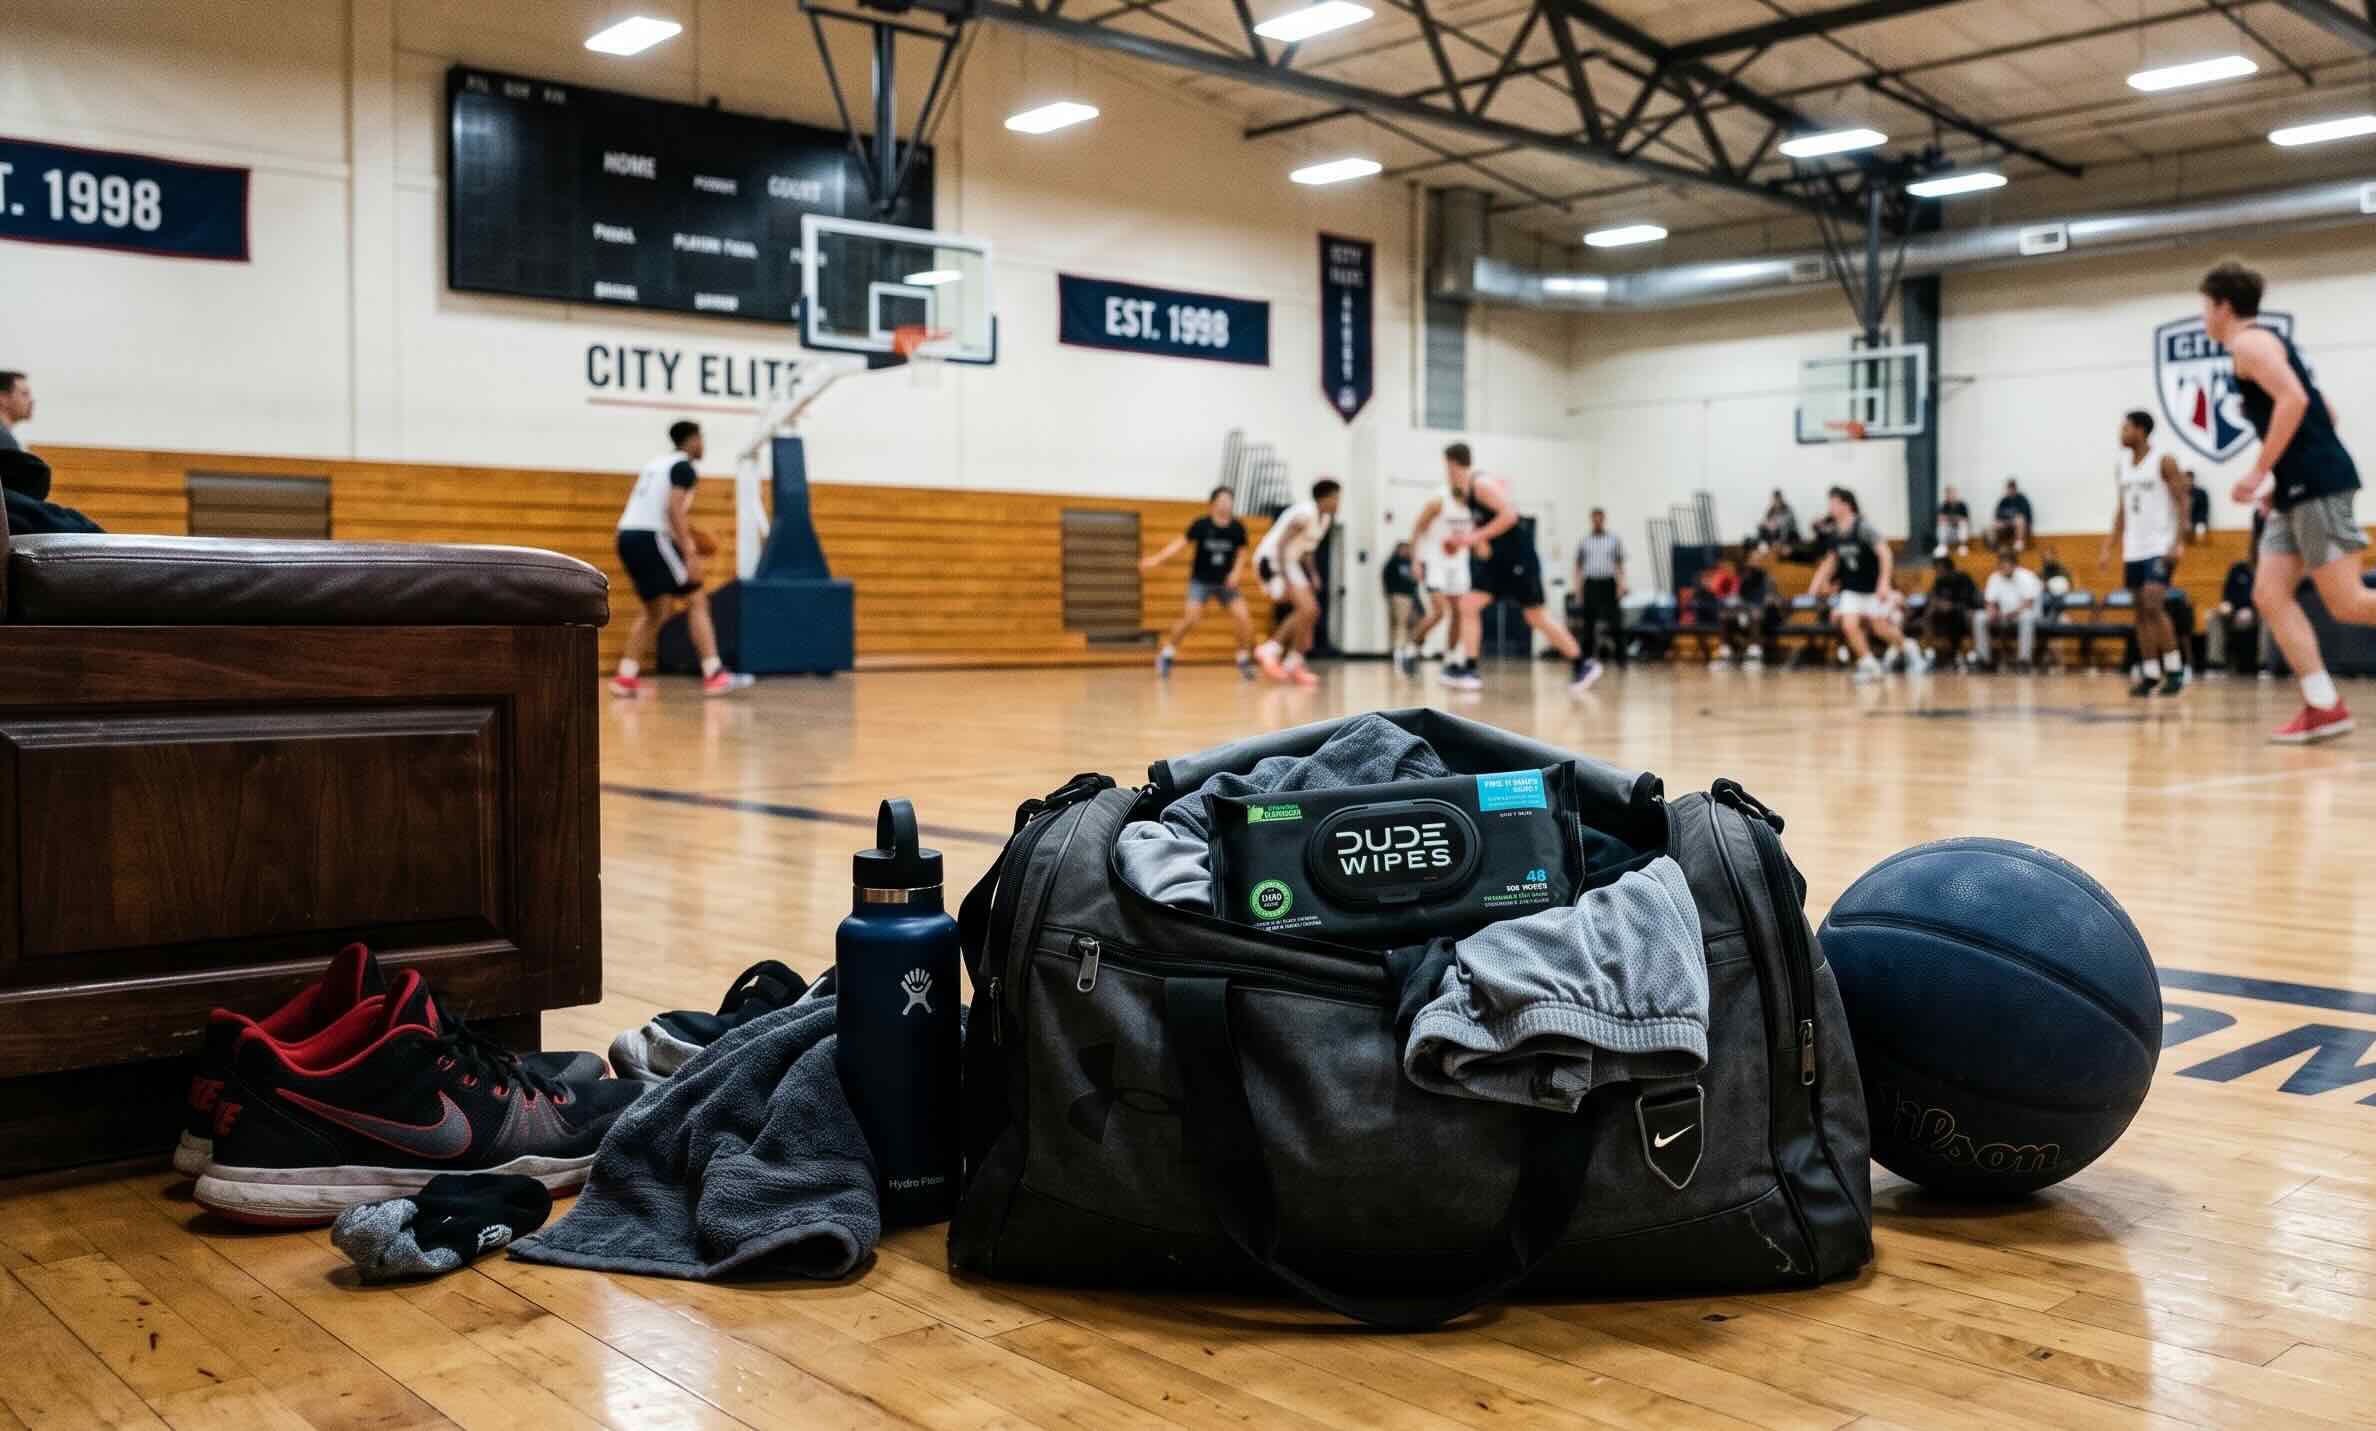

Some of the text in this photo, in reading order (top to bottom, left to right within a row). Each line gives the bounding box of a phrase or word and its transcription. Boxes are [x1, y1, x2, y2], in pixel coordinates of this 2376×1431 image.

[43, 168, 162, 231] 1998
[1105, 296, 1229, 348] EST. 1998
[587, 345, 680, 391] CITY
[1336, 823, 1449, 855] DUDE
[1340, 848, 1451, 875] WIPES
[1526, 869, 1546, 882] 48
[889, 1178, 920, 1191] Hydro
